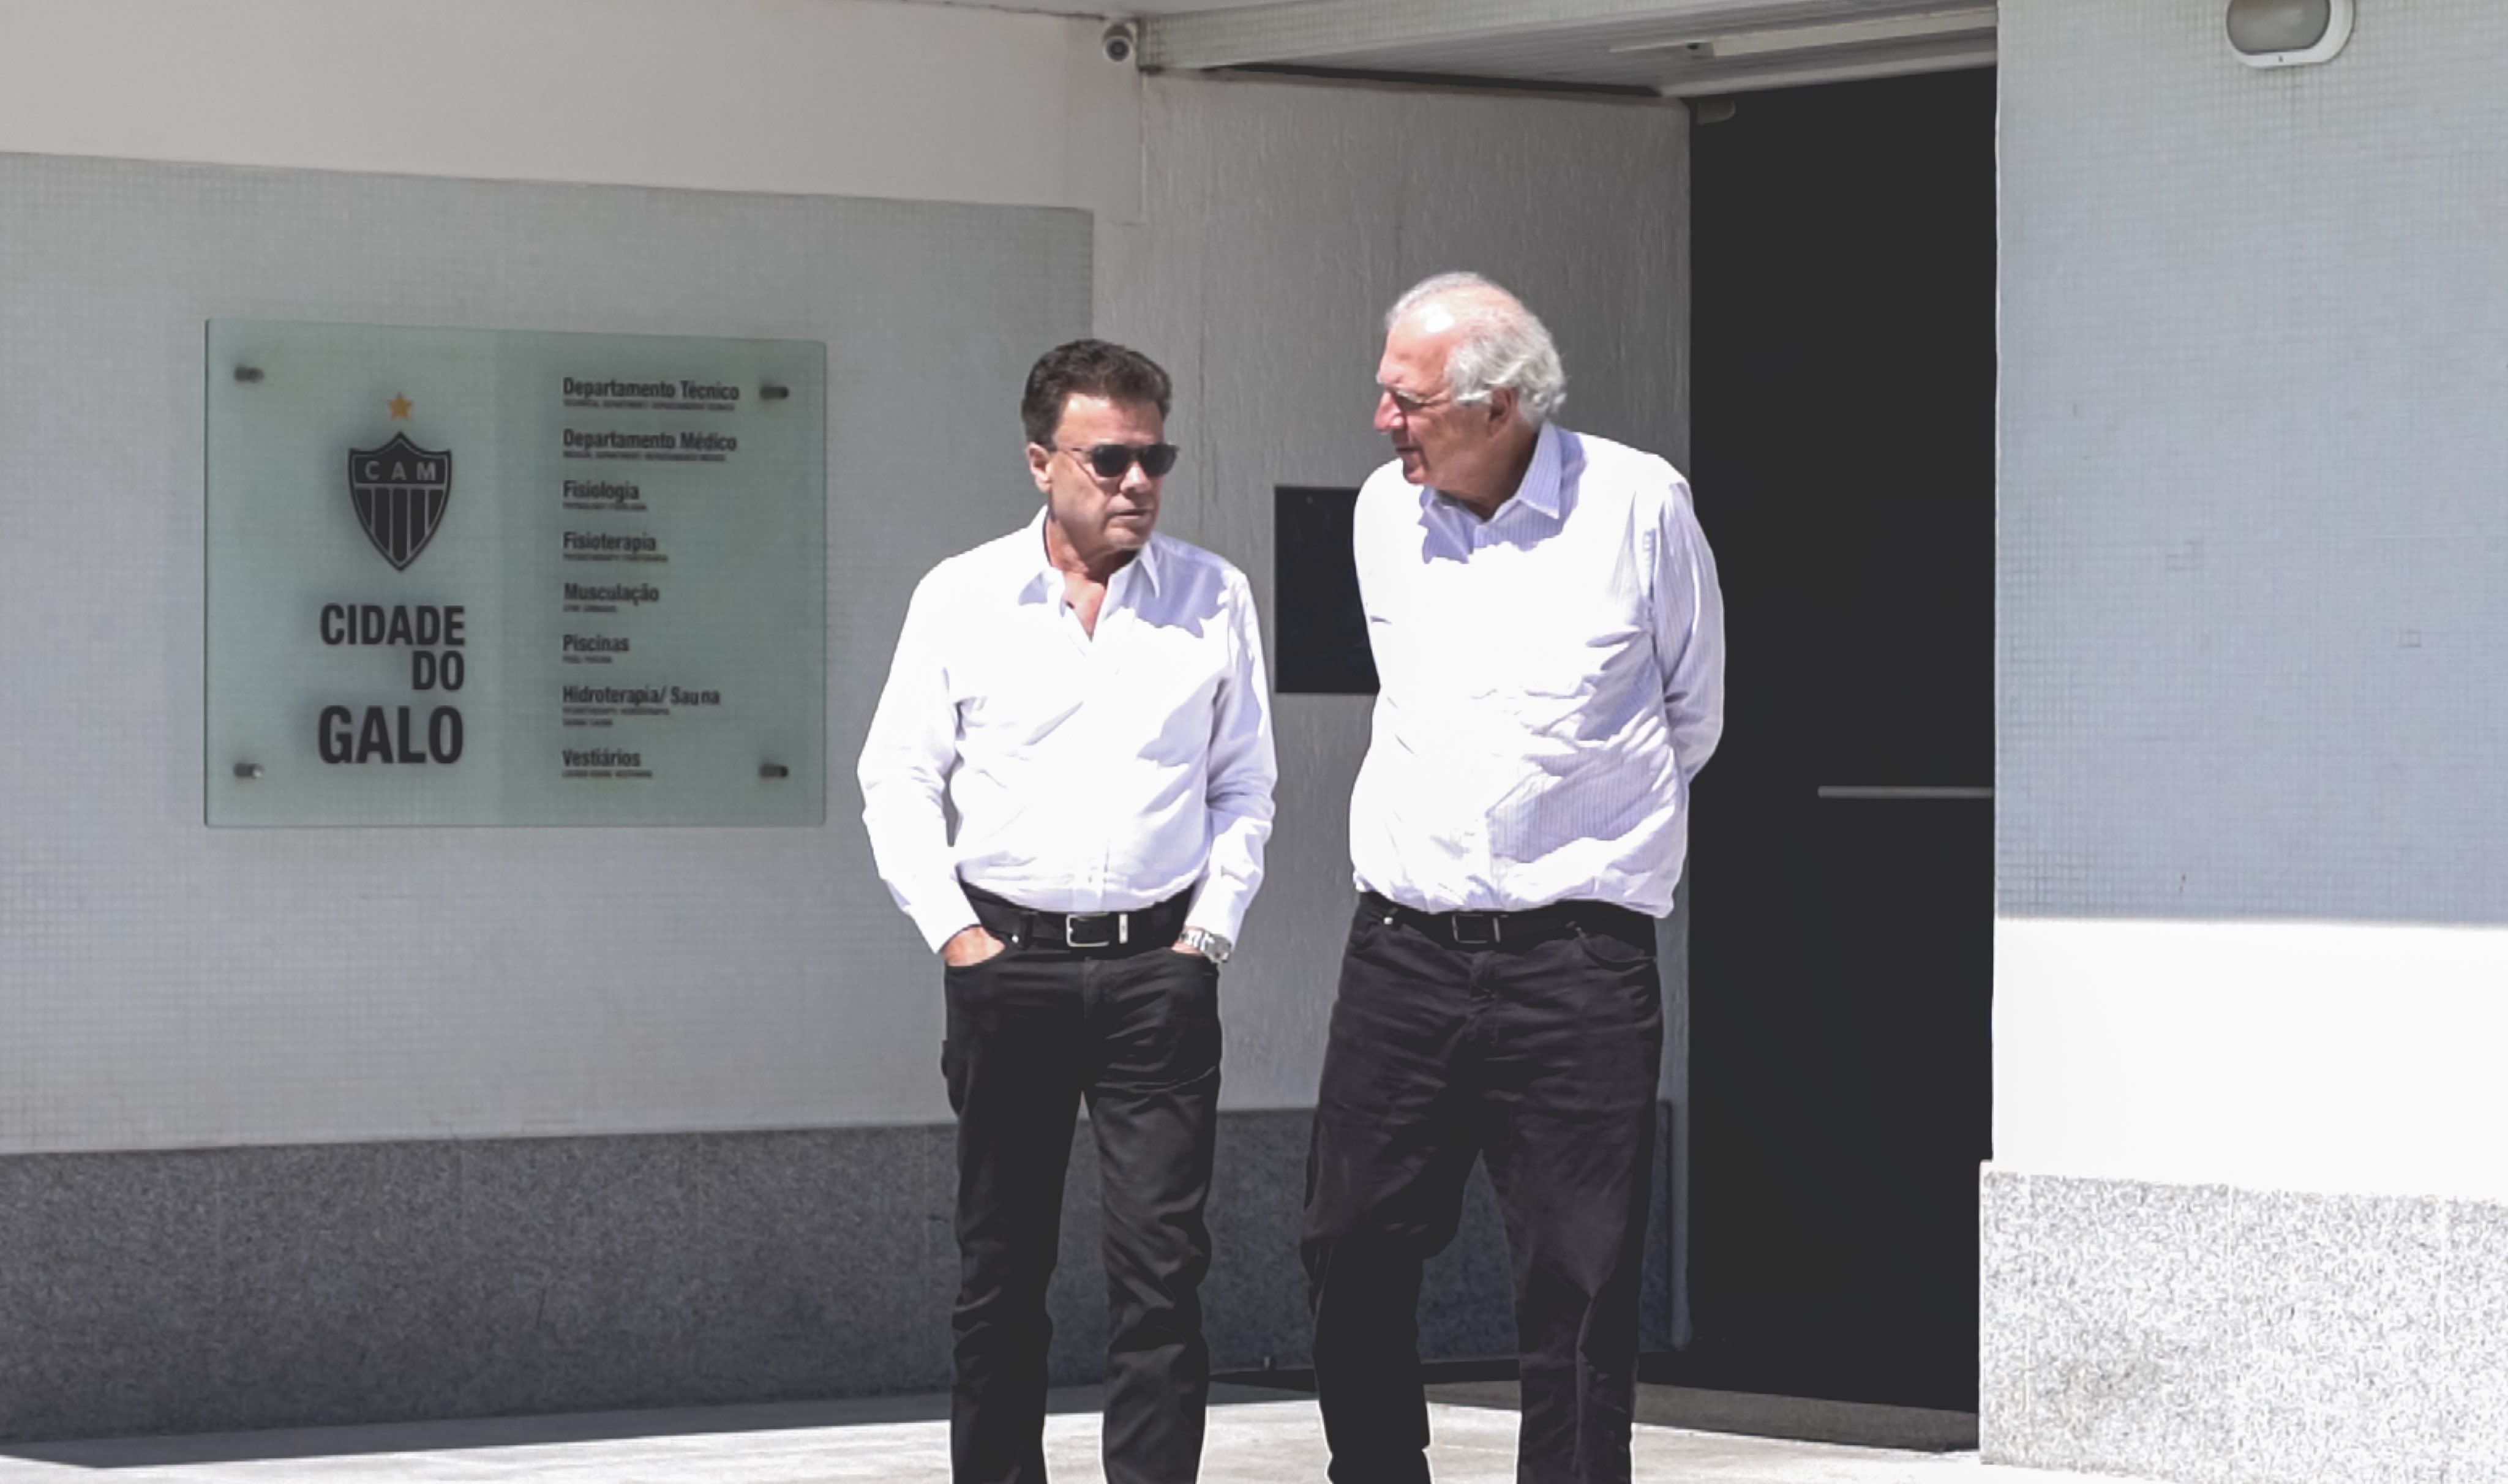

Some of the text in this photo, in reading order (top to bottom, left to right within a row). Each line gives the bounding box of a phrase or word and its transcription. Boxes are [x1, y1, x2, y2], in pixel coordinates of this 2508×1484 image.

[563, 377, 675, 398] Departamento
[563, 428, 737, 451] Departamento Médico
[364, 460, 437, 481] CAM
[563, 480, 640, 503] Fisiologia
[563, 531, 656, 554] Fisioterapia
[564, 582, 660, 607] Musculação
[320, 603, 465, 646] CIDADE
[563, 634, 630, 653] Piscinas
[411, 650, 465, 691] DO
[318, 705, 464, 764] GALO
[562, 748, 640, 767] Vestiários
